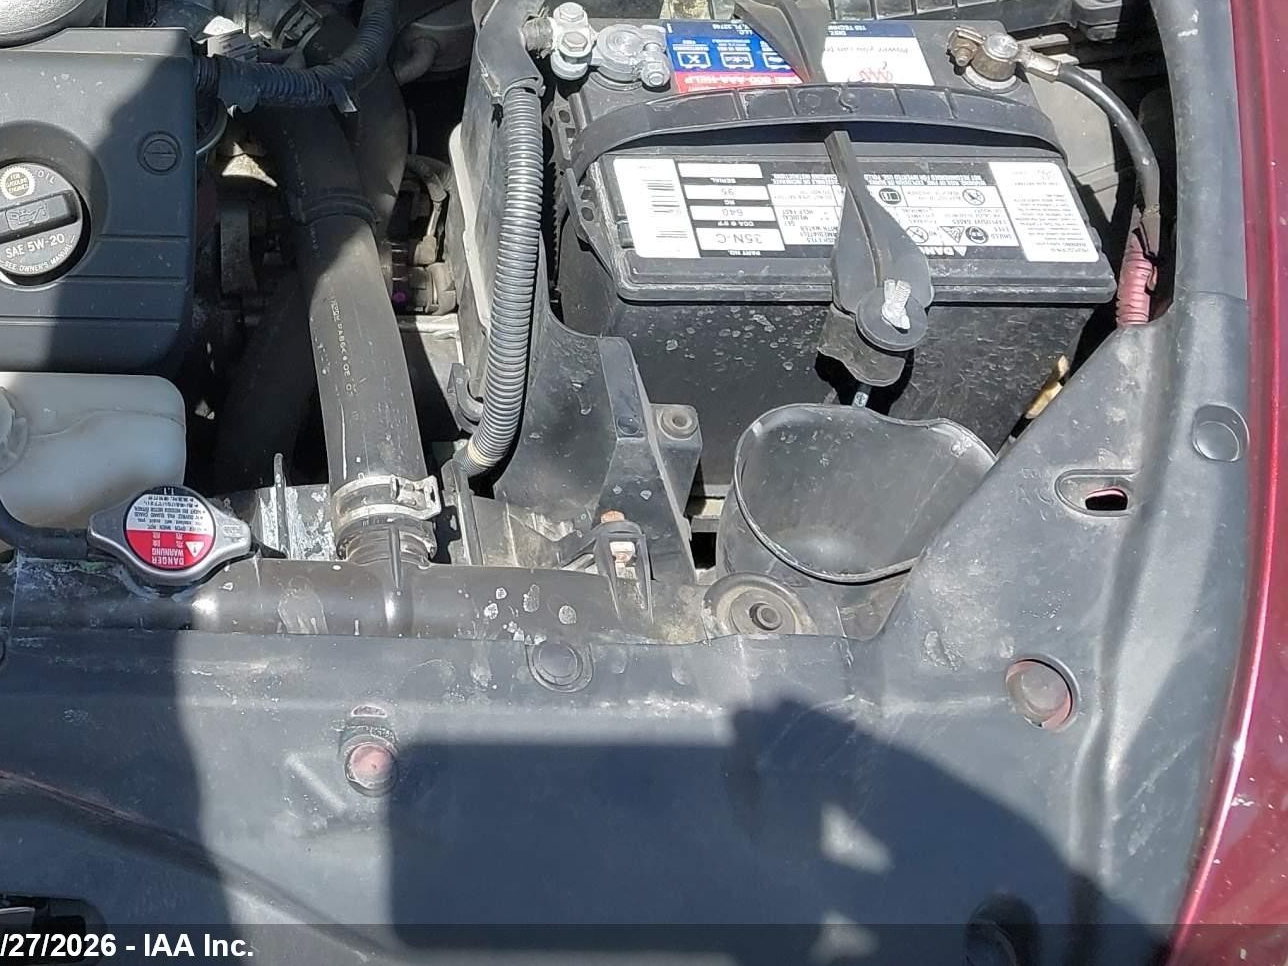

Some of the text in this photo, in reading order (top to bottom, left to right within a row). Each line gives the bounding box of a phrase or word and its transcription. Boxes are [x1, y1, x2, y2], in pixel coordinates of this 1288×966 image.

[37, 169, 56, 184] OIL
[715, 233, 763, 244] 35N-C
[5, 233, 65, 258] SAE 5W-20
[152, 556, 184, 565] DANGER
